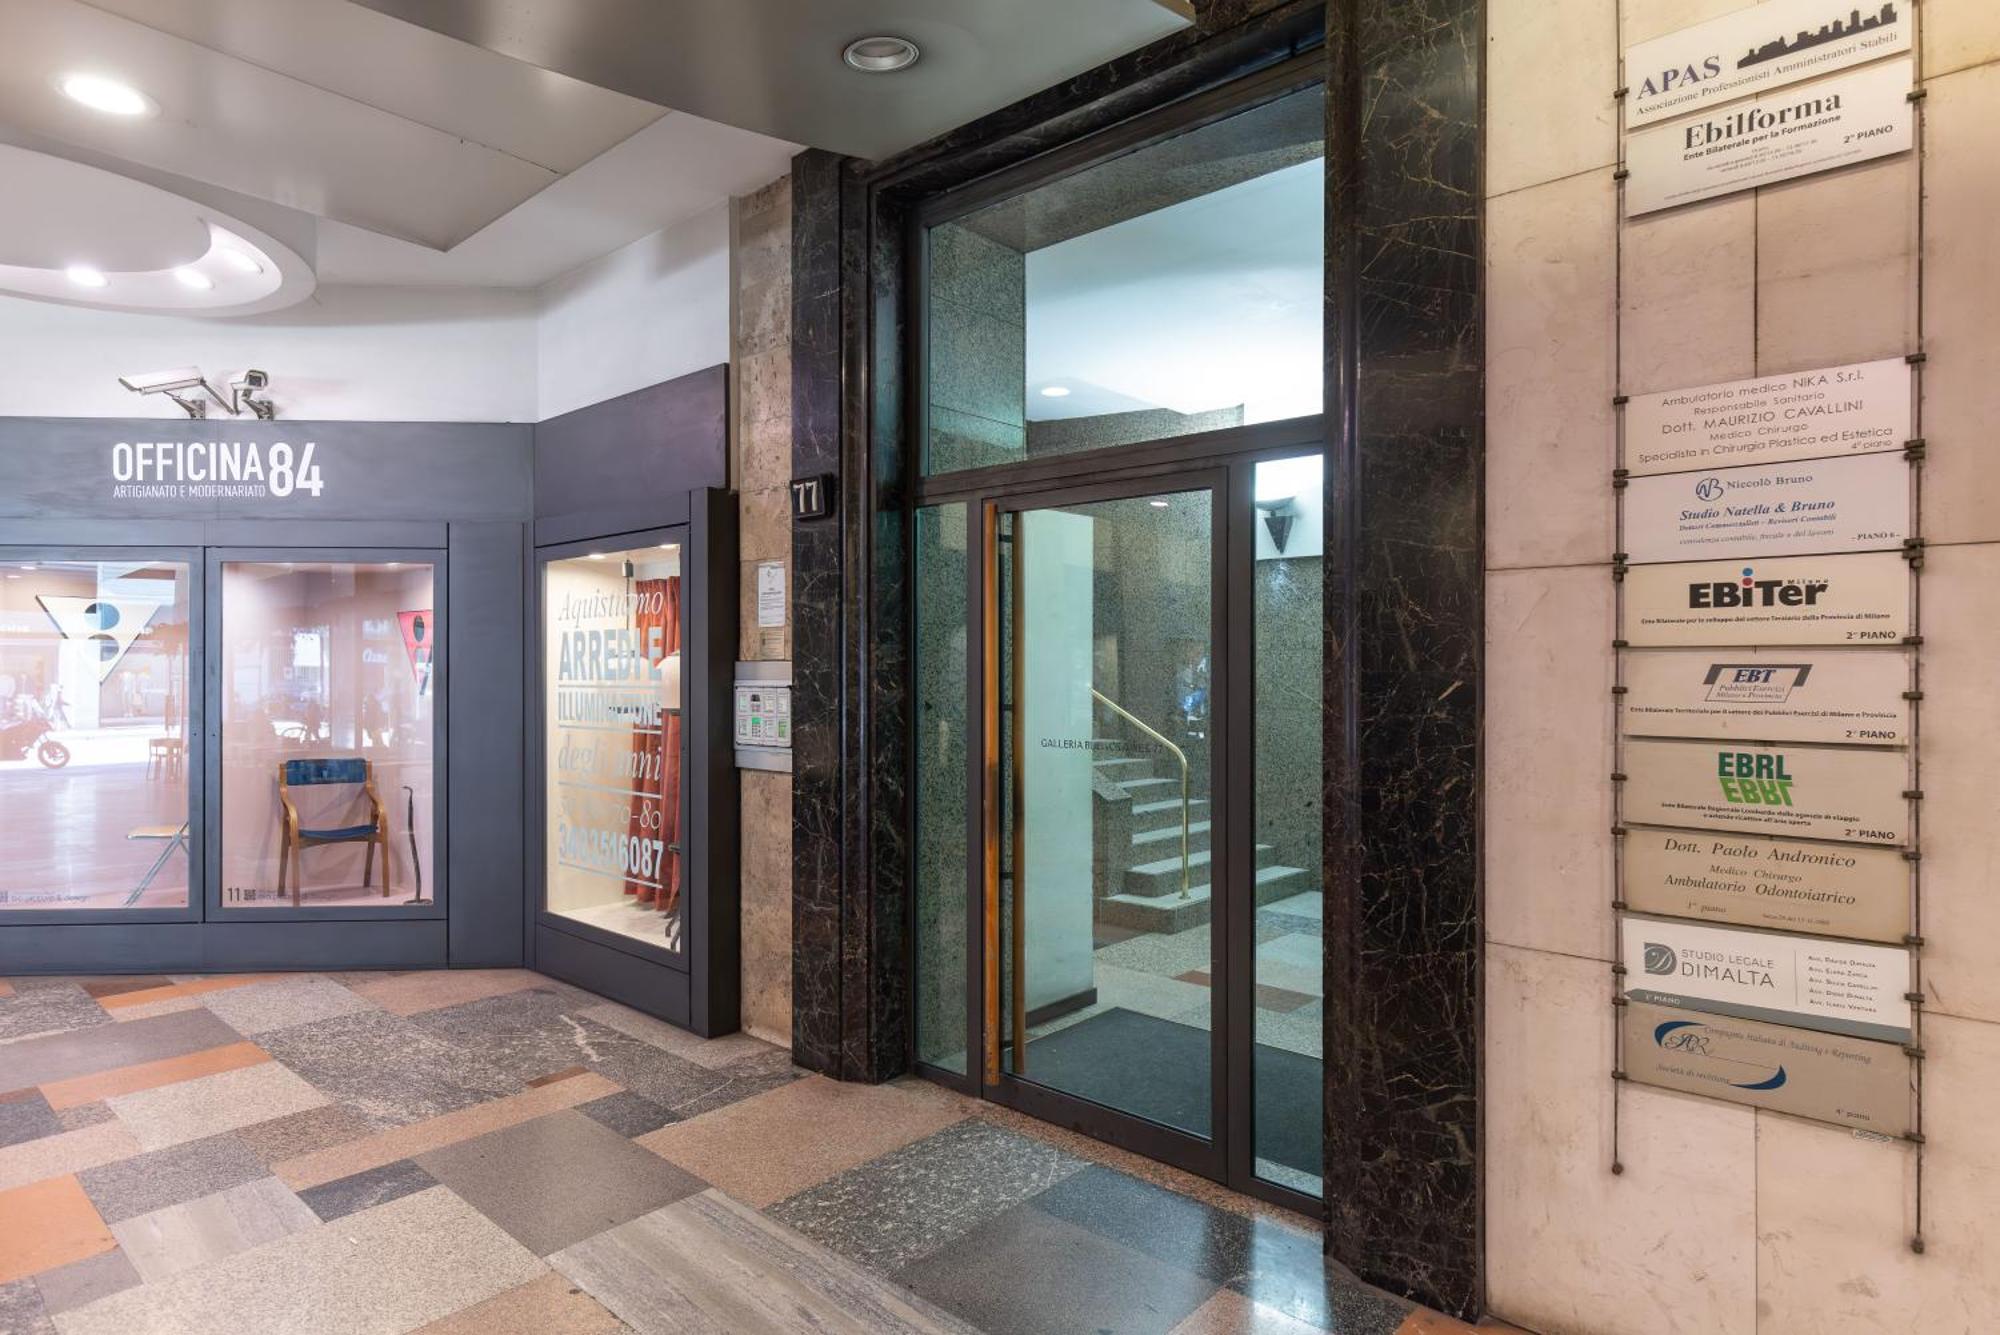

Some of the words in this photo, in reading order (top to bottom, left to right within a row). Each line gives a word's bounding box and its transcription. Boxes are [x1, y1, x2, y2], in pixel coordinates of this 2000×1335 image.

[1637, 90, 1699, 115] Associazione
[1702, 69, 1770, 97] Professionisti
[1773, 46, 1857, 76] Amministratori
[1860, 32, 1897, 50] Stabili
[1637, 55, 1720, 100] APAS
[1685, 94, 1841, 150] Ebilforma
[1857, 125, 1893, 140] PIANO
[1684, 150, 1704, 161] Ente
[1706, 138, 1749, 156] Bilaterale
[1752, 134, 1769, 146] per
[1770, 130, 1780, 139] la
[1782, 115, 1841, 135] Formazione
[1662, 390, 1734, 407] Ambulatorio
[1739, 382, 1786, 397] medico
[1793, 375, 1829, 389] NIKA
[1836, 370, 1864, 382] S.r.l.
[1694, 398, 1767, 416] Responsabile
[1773, 391, 1825, 406] Sanitario
[1662, 421, 1696, 434] Dott.
[1704, 411, 1775, 430] MAURIZIO
[1784, 400, 1863, 420] CAVALLINI
[1710, 430, 1752, 441] Medico
[1757, 422, 1808, 437] Chirurgo
[1639, 448, 1697, 464] Specialista
[1700, 446, 1710, 456] in
[1713, 440, 1765, 456] Chirurgia
[1768, 434, 1816, 449] Plastica
[1820, 430, 1838, 442] ed
[1842, 427, 1893, 441] Estetica
[112, 442, 265, 481] OFFICINA
[269, 442, 324, 497] 84
[113, 484, 177, 498] ARTIGIANATO
[180, 484, 186, 497] E
[188, 484, 266, 498] MODERNARIATO
[1727, 478, 1771, 490] Niccolò
[1776, 474, 1813, 485] Bruno
[1679, 508, 1720, 521] Studio
[1724, 502, 1770, 517] Natella
[1773, 502, 1787, 514] &
[1791, 499, 1836, 512] Bruno
[1860, 631, 1896, 640] PIANO
[1733, 669, 1776, 683] EBT
[1041, 738, 1083, 749] GALLERIA
[1860, 730, 1896, 740] PIANO
[1718, 752, 1792, 780] EBRL
[1859, 830, 1896, 840] PIANO
[1664, 838, 1701, 854] Dott.
[1712, 842, 1758, 859] Paolo
[1766, 847, 1856, 868] Andronico
[1709, 864, 1747, 877] Medico
[1753, 869, 1802, 883] Chirurgo
[227, 887, 240, 902] 11
[1664, 874, 1746, 893] Ambulatorio
[1755, 883, 1856, 905] Odontoiatrico
[1681, 949, 1723, 962] STUDIO
[1728, 955, 1774, 969] LEGALE
[1681, 962, 1775, 988] DIMALTA
[1654, 995, 1681, 1005] PIANO
